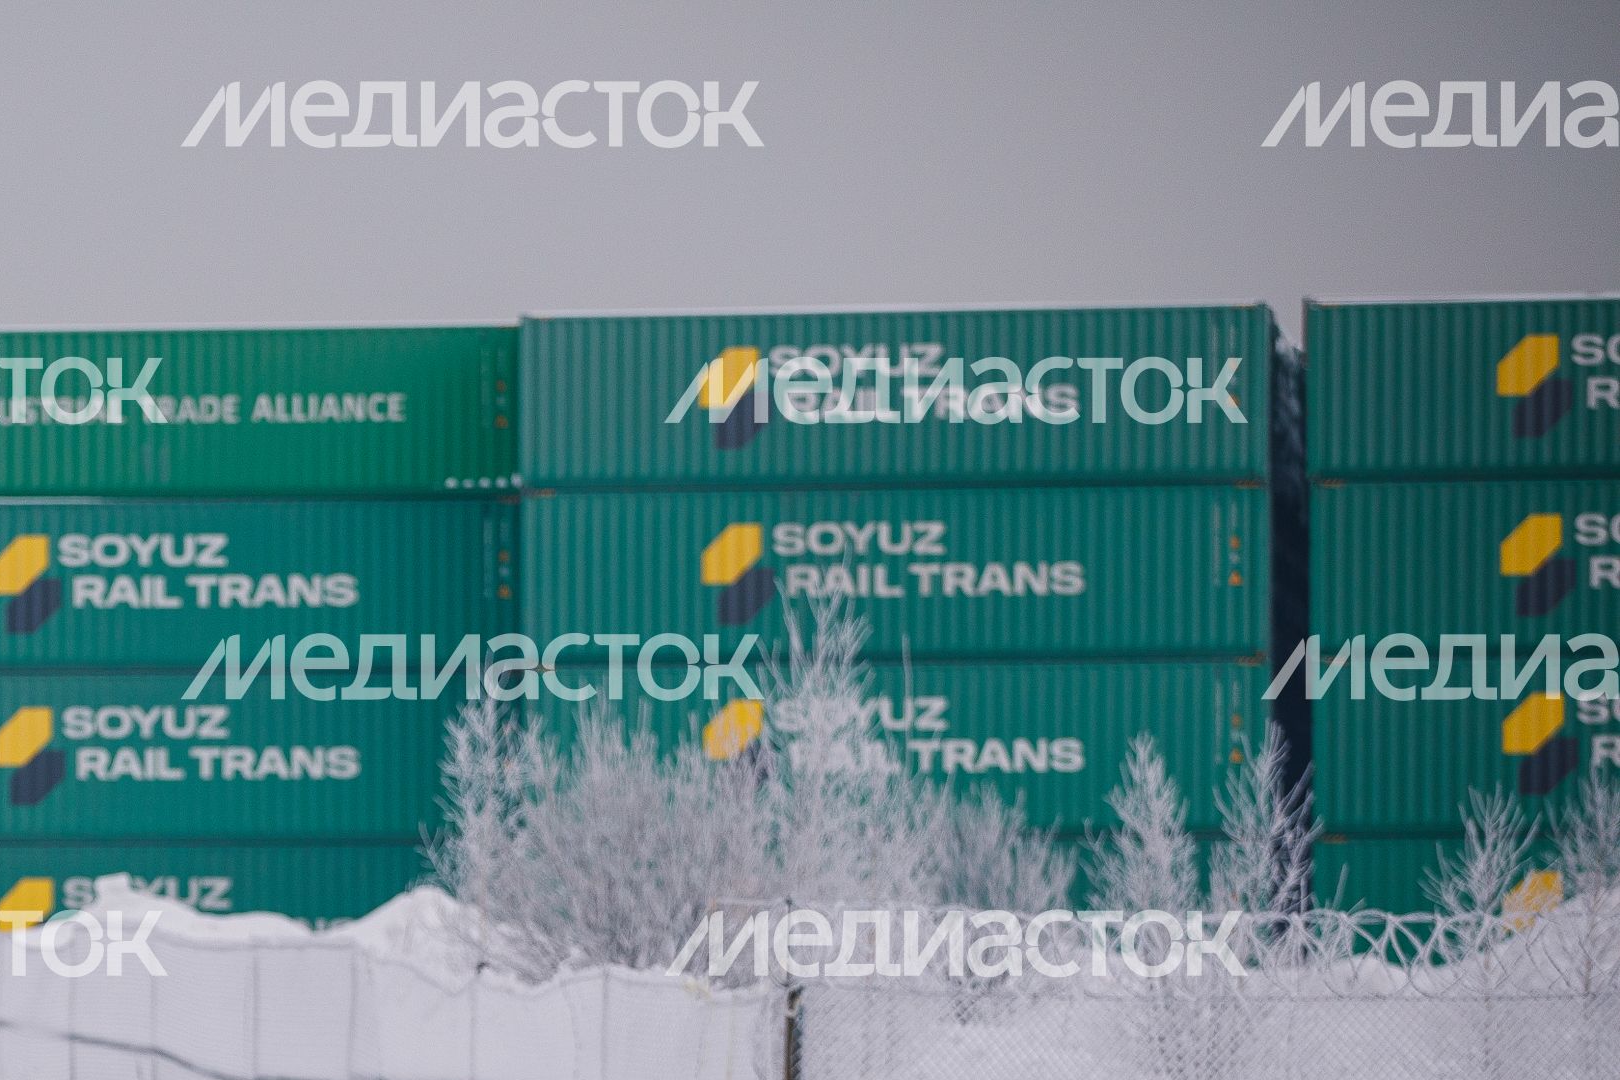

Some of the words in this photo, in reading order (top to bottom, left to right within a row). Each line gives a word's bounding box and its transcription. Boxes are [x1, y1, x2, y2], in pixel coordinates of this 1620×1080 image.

[251, 392, 406, 424] ALLIANCE
[57, 532, 229, 568] SOYUZ
[772, 520, 947, 556] SOYUZ
[72, 573, 184, 609] RAIL
[185, 571, 360, 609] TRANS
[786, 564, 905, 598] RAIL
[908, 561, 1086, 598] TRANS
[61, 705, 230, 740] SOYUZ
[75, 746, 186, 781] RAIL
[188, 745, 362, 780] TRANS
[907, 738, 1085, 773] TRANS
